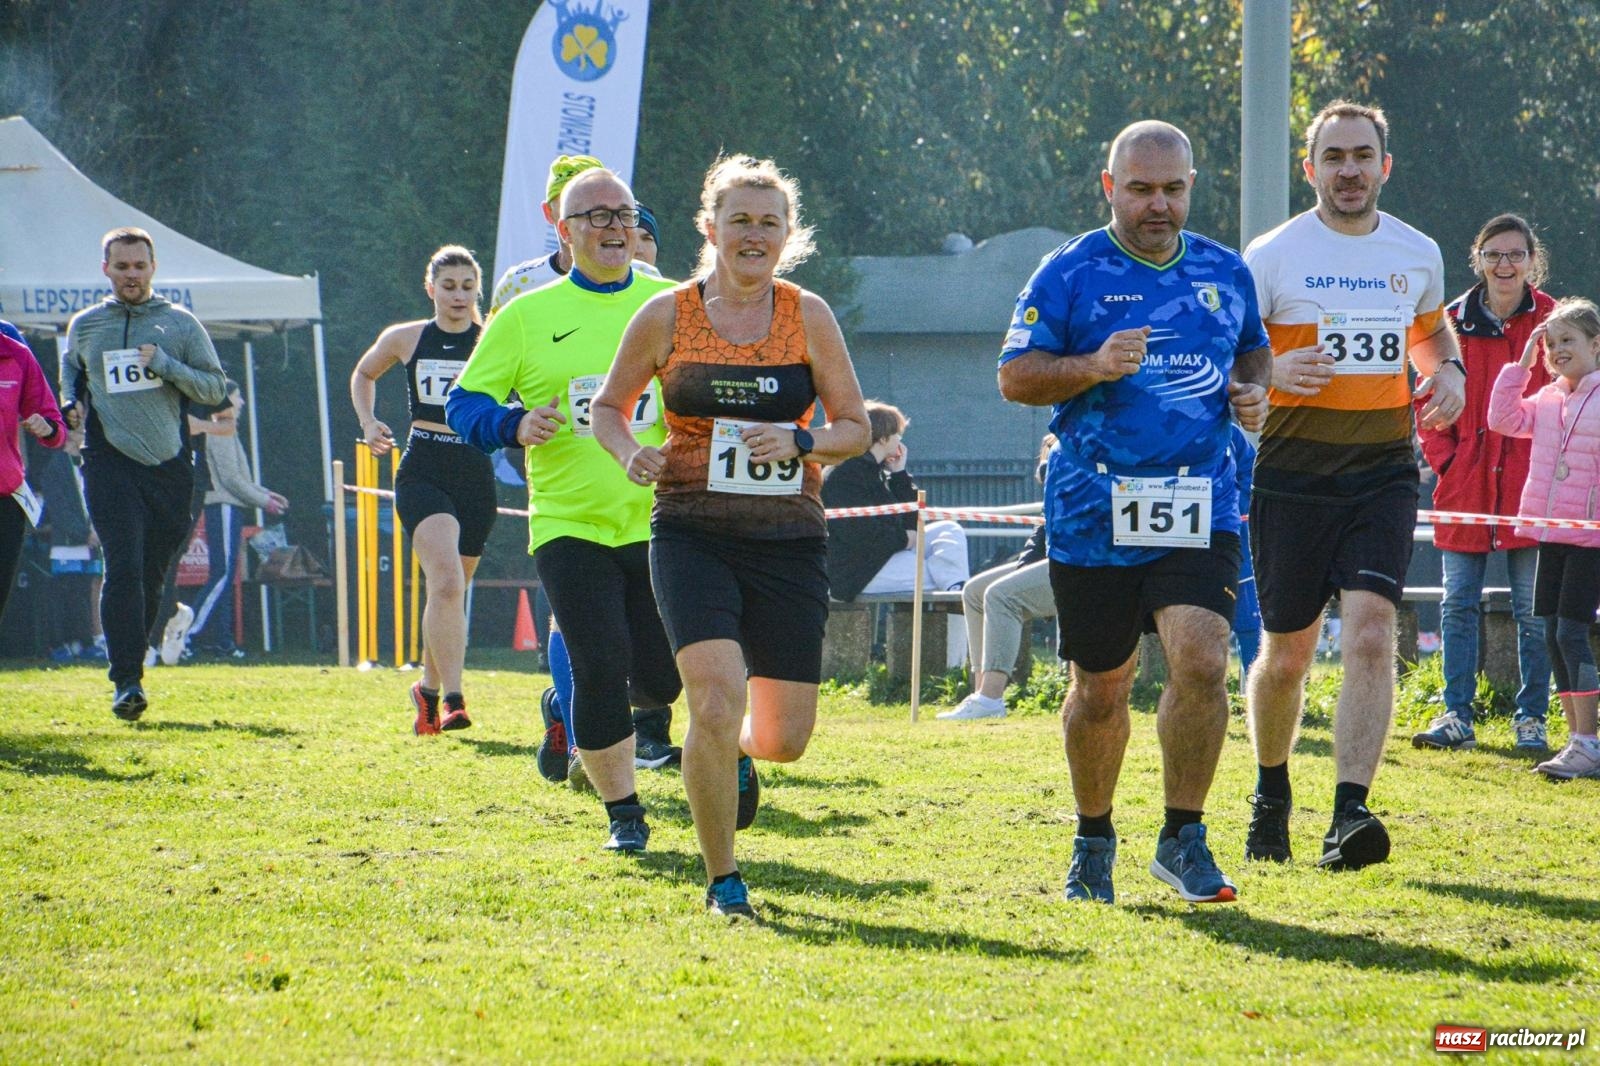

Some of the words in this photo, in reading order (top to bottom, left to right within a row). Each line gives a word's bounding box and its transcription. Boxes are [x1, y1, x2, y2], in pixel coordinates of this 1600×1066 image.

[558, 92, 595, 155] STOWARZ
[1305, 276, 1335, 289] SAP
[1339, 276, 1386, 292] Hybris
[1324, 332, 1400, 362] 338
[420, 375, 459, 397] 17
[756, 376, 779, 394] 10
[575, 391, 651, 426] 37
[433, 433, 464, 444] NIKE
[718, 446, 800, 482] 169
[1121, 500, 1201, 535] 151
